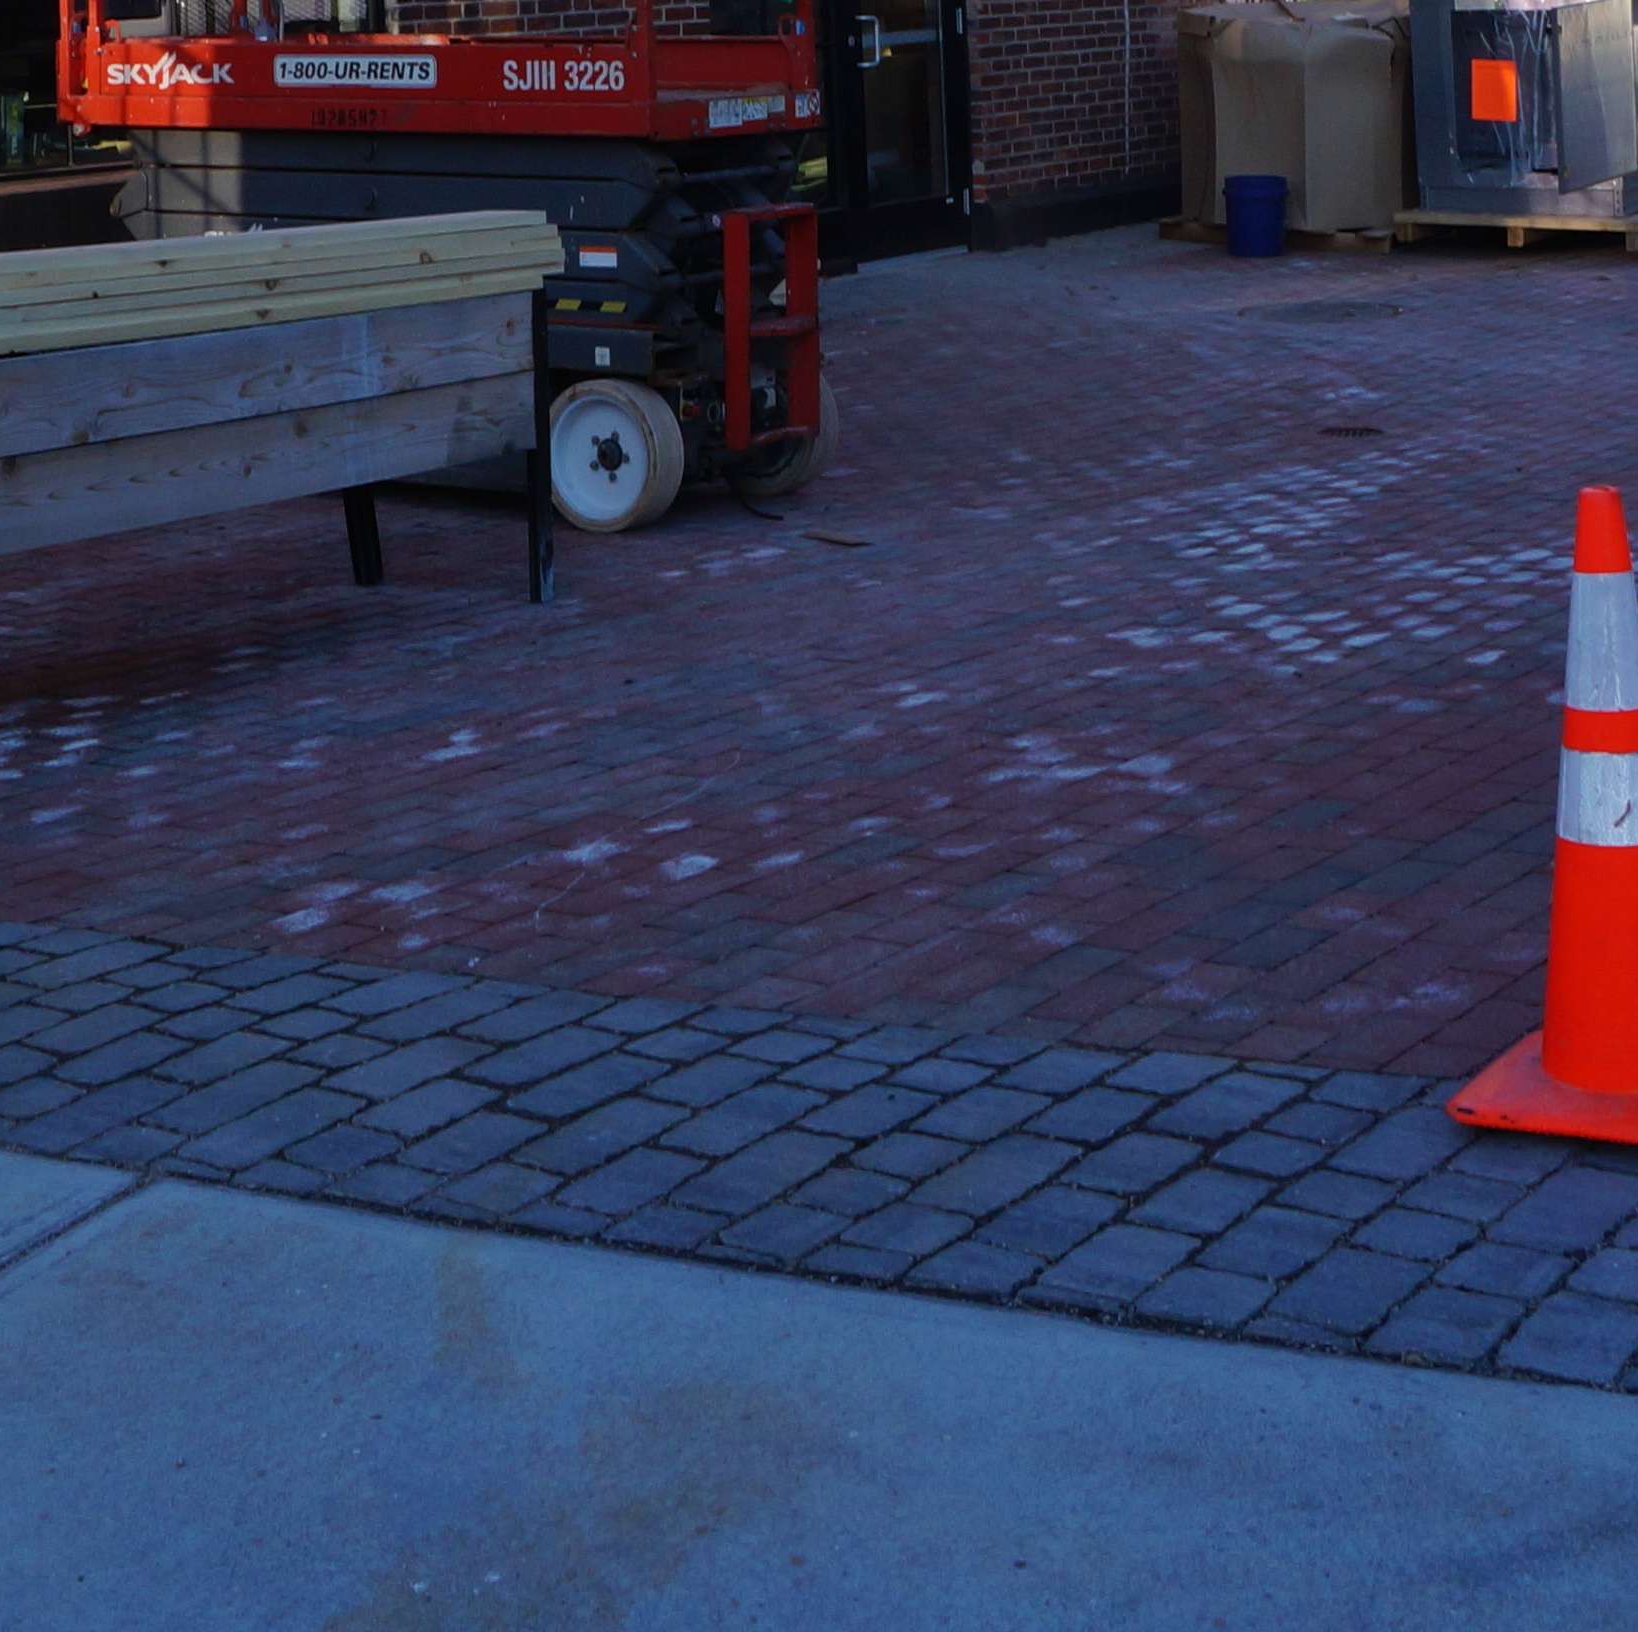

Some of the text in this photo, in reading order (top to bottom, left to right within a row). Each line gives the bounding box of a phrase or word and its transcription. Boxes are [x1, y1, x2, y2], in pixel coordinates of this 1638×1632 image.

[107, 51, 235, 90] SKYJACK
[278, 61, 431, 80] 1-800-UR-RENTS
[502, 59, 626, 91] SJIII 3226
